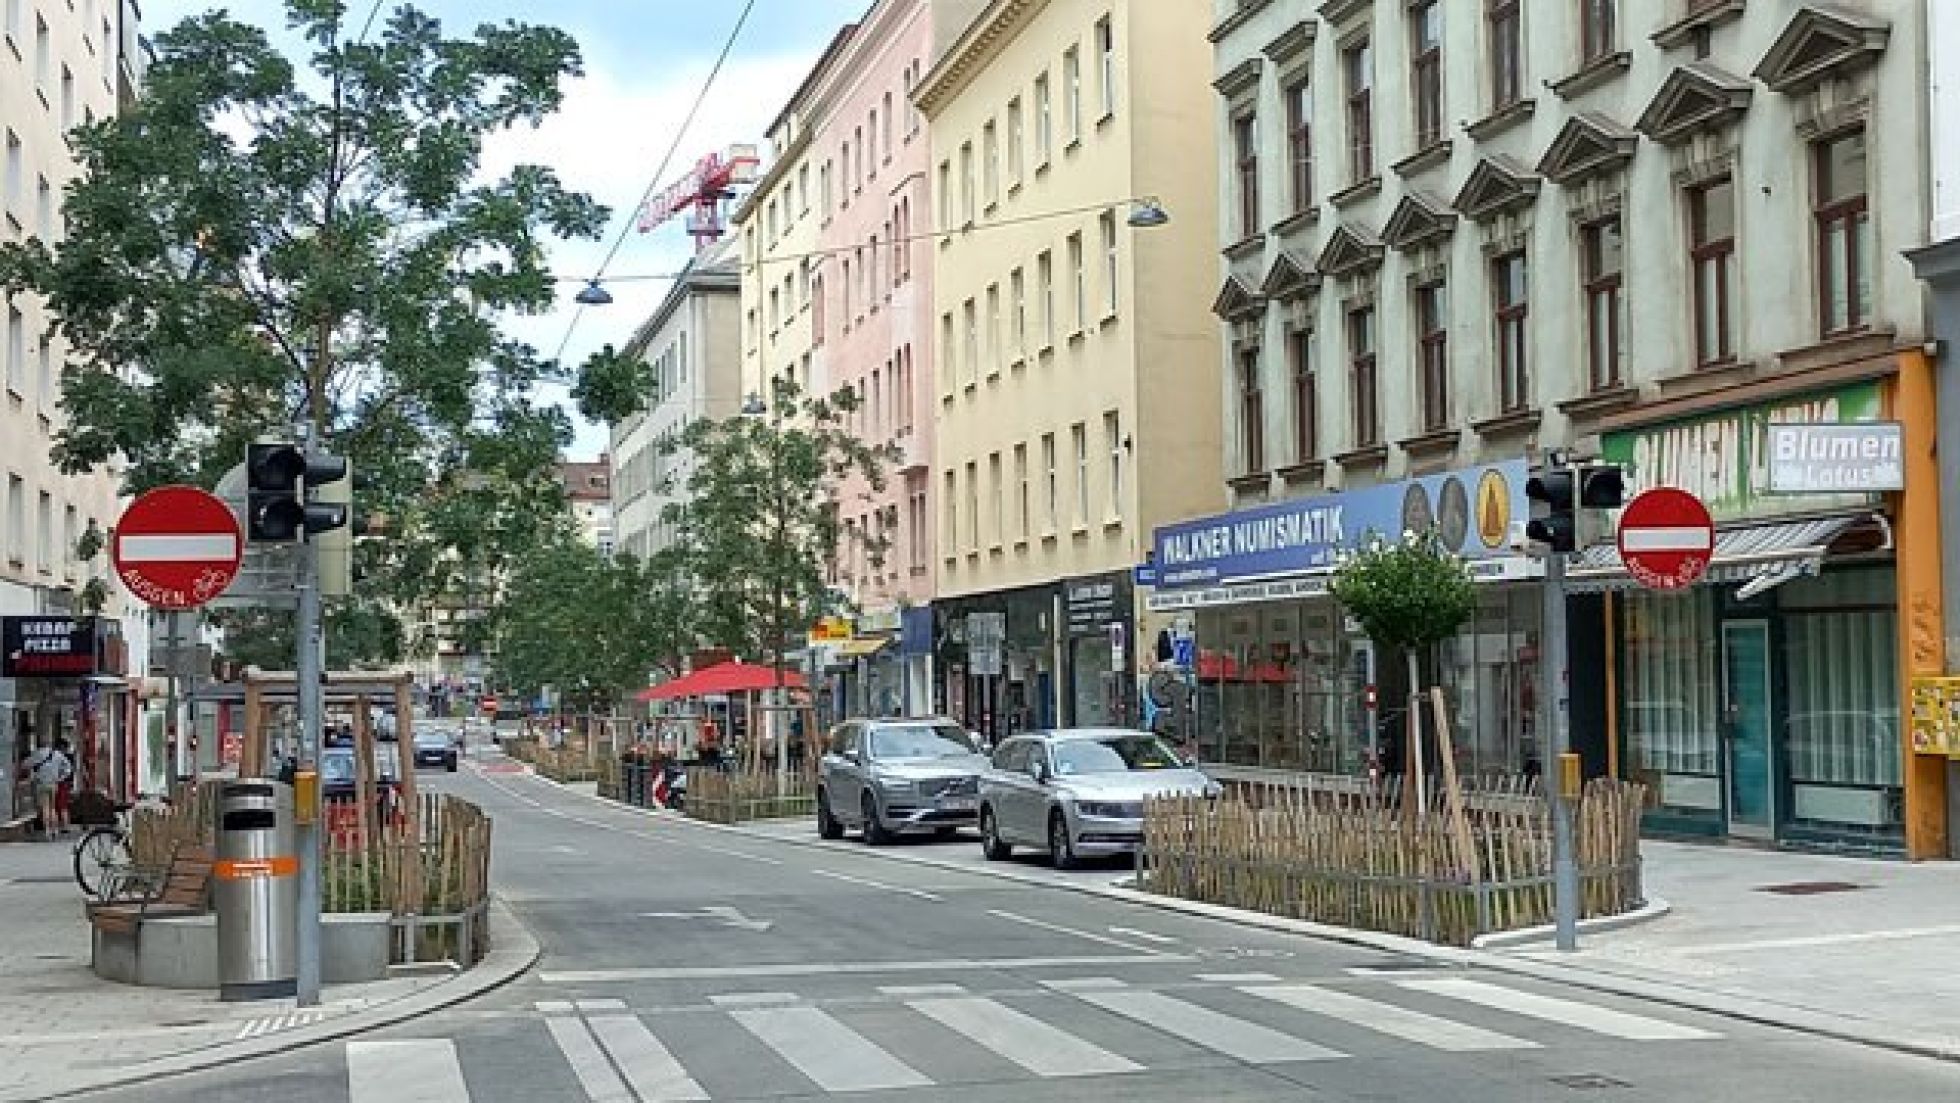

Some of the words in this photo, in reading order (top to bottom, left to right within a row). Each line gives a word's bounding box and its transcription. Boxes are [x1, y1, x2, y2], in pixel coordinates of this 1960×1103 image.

[1776, 430, 1899, 461] Blumen
[1807, 463, 1872, 488] Lotus
[1164, 525, 1231, 565] WALKNER
[1234, 504, 1343, 553] NUMISMATIK
